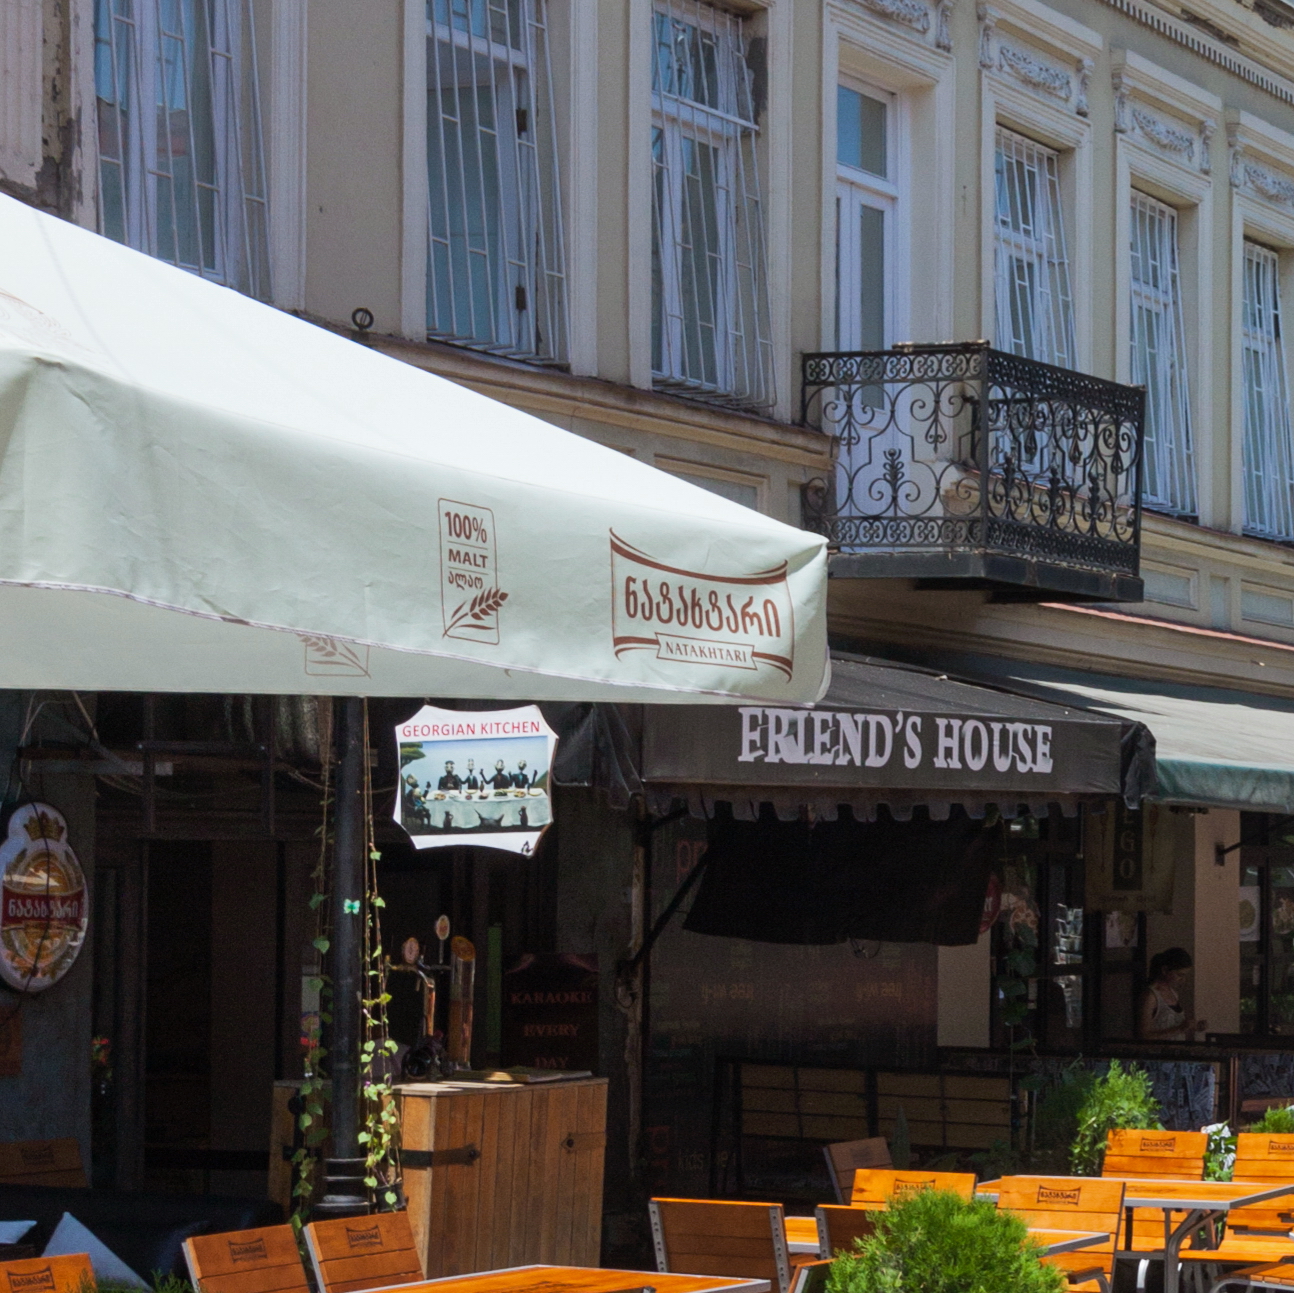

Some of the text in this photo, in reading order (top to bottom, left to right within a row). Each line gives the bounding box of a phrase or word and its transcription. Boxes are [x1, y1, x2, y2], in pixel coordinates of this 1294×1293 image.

[444, 511, 488, 544] 100%
[448, 548, 488, 569] MALT
[448, 571, 483, 590] ალაო
[625, 575, 781, 638] ნატახტარი
[665, 641, 747, 663] NATAKHTARI
[402, 721, 540, 737] GEORGIAN KITCHEN
[738, 706, 1054, 774] FRIEND'S HOUSE
[509, 991, 593, 1005] KARAOKE
[523, 1024, 579, 1037] EVERY
